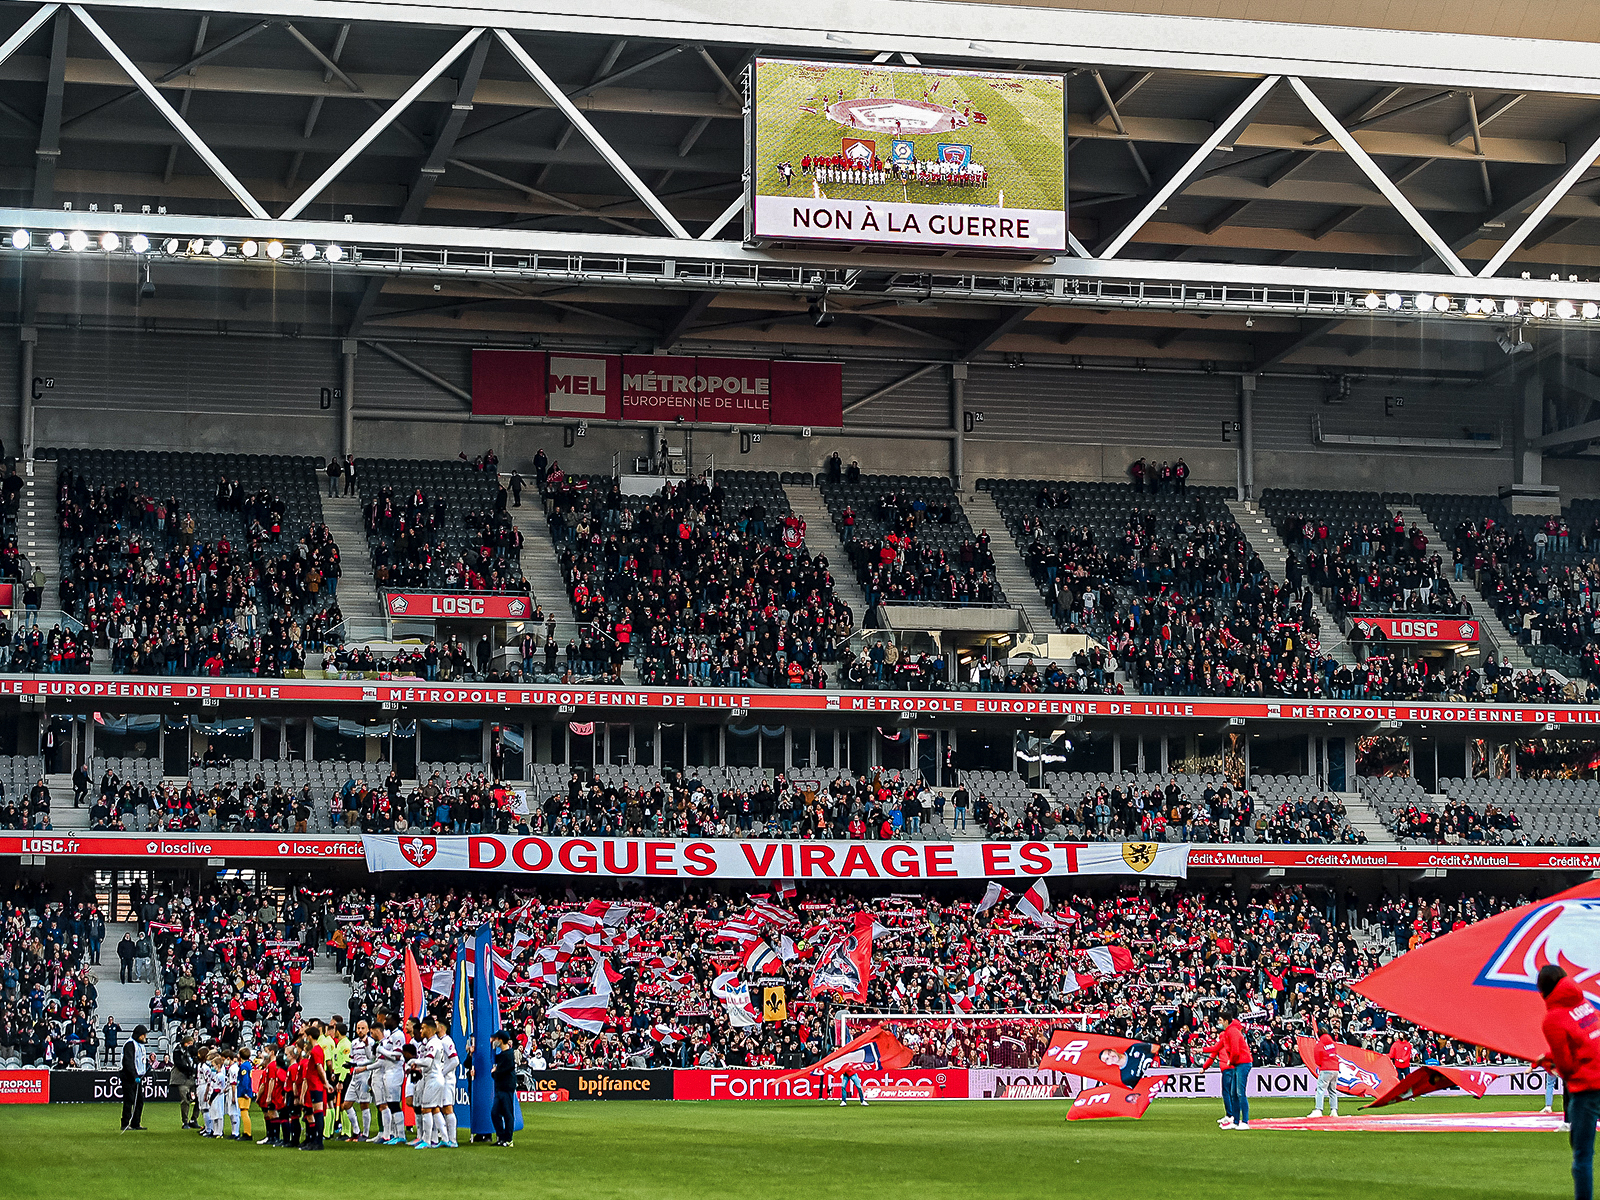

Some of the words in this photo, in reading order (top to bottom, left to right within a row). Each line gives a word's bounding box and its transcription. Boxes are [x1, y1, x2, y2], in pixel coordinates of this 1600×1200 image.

[792, 208, 851, 230] NON
[861, 206, 880, 232] À
[888, 212, 922, 234] LA
[928, 214, 1030, 239] GUERRE
[32, 377, 43, 400] C
[550, 374, 606, 395] MEL
[622, 370, 770, 396] MÉTROPOLE
[320, 388, 332, 410] D
[622, 394, 711, 408] EUROPÉENNE
[716, 398, 732, 408] DE
[736, 398, 770, 410] LILLE
[1385, 396, 1394, 416] E
[964, 412, 974, 432] D
[564, 426, 574, 448] D
[577, 428, 586, 436] 22
[1222, 421, 1232, 442] E
[740, 432, 752, 454] D
[752, 434, 762, 442] 23
[432, 597, 484, 614] LOSC
[1392, 622, 1438, 637] LOSC
[38, 682, 172, 696] EUROPÉENNE
[187, 686, 210, 697] DE
[226, 686, 280, 699] LILLE
[390, 688, 507, 703] MÉTROPOLE
[521, 691, 648, 706] EUROPÉENNE
[662, 694, 685, 706] DE
[700, 696, 750, 708] LILLE
[852, 697, 962, 710] MÉTROPOLE
[976, 700, 1096, 714] EUROPÉENNE
[1110, 704, 1132, 714] DE
[1145, 704, 1194, 716] LILLE
[1292, 706, 1396, 719] MÉTROPOLE
[1409, 708, 1523, 722] EUROPÉENNE
[1535, 712, 1556, 722] DE
[22, 840, 80, 853] LOSC.fr
[160, 842, 212, 854] losclive
[468, 836, 718, 876] DOGUES
[740, 842, 958, 878] VIRAGE
[981, 842, 1089, 876] EST
[1188, 854, 1214, 864] rédit
[1226, 854, 1263, 864] Mutuel
[1306, 854, 1338, 865] Crédit
[1352, 855, 1388, 865] Mutuel
[1428, 855, 1461, 865] Crédit
[1474, 856, 1509, 866] Mutuel
[1549, 856, 1581, 866] Crédit
[578, 1074, 651, 1096] bpifrance
[1008, 1086, 1052, 1098] WINAMAX
[1257, 1074, 1308, 1092] NON
[518, 1092, 542, 1102] OSC
[898, 1089, 930, 1097] balance
